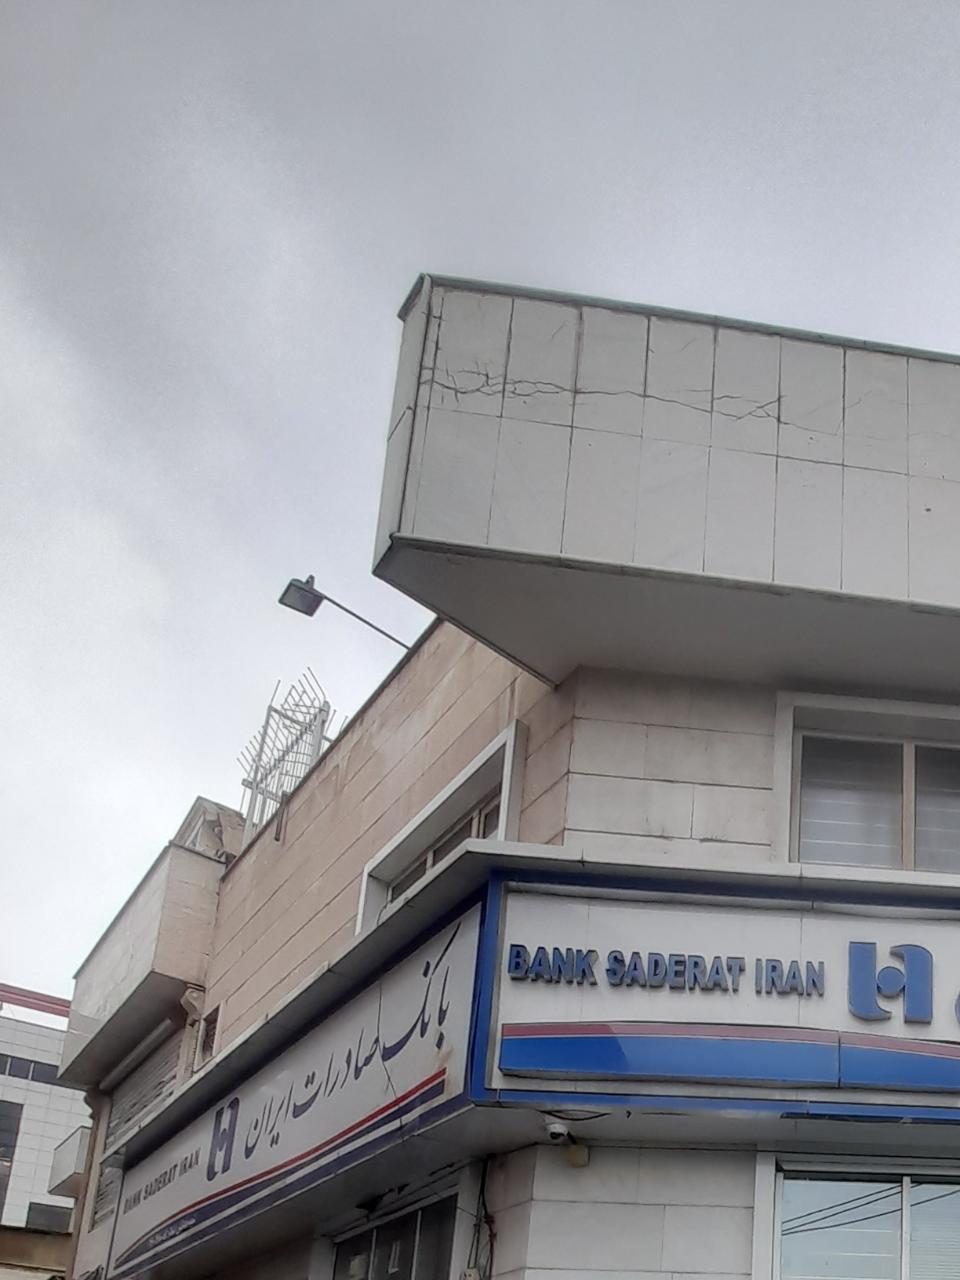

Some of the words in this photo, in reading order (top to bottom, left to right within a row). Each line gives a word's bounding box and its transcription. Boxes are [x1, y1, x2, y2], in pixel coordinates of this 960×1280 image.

[508, 943, 597, 986] BANK
[606, 949, 745, 992] SADERAT
[755, 957, 825, 997] IRAN
[292, 1027, 380, 1119] صادرات
[245, 1080, 294, 1160] ایران
